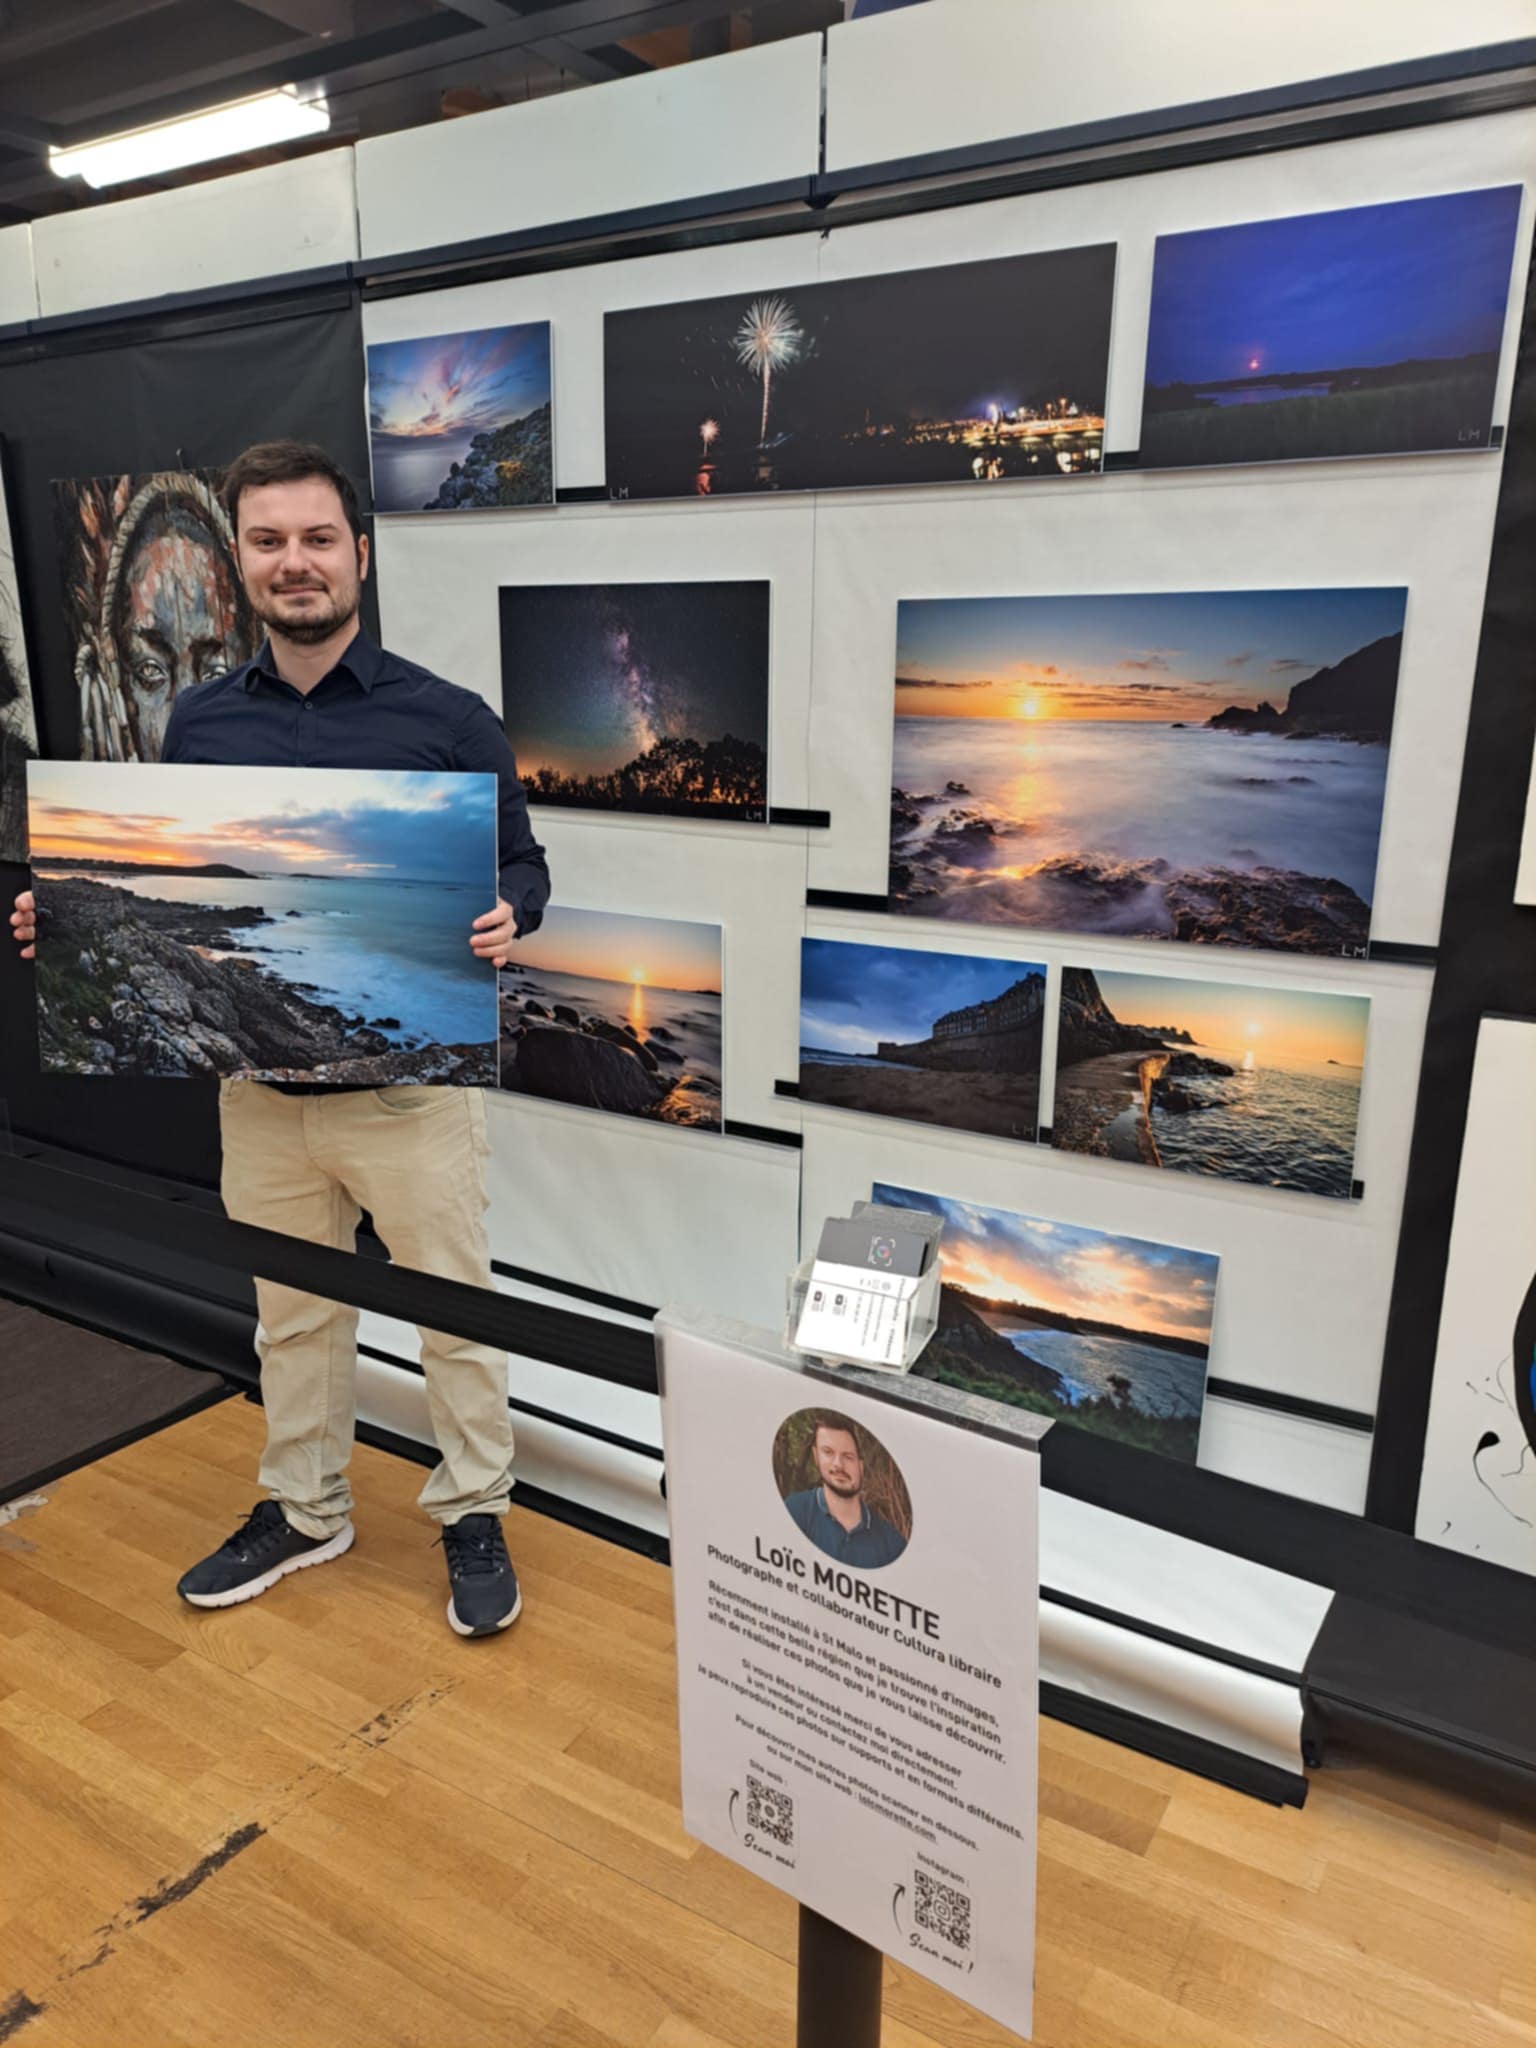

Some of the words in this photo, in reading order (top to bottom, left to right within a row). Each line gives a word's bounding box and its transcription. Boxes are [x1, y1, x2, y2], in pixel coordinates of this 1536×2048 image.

[609, 487, 629, 500] LM
[1341, 944, 1366, 957] LM
[707, 1544, 783, 1587] Photographe
[786, 1582, 799, 1594] et
[802, 1589, 889, 1636] collaborateur
[893, 1629, 945, 1664] Cultura
[949, 1653, 1002, 1689] libraire
[708, 1580, 769, 1616] Récemment
[771, 1609, 810, 1634] installé
[813, 1629, 819, 1639] à
[822, 1632, 833, 1646] St
[836, 1639, 863, 1660] Malo
[865, 1655, 876, 1667] et
[879, 1661, 938, 1696] passionné
[755, 1536, 806, 1577] Loïc
[813, 1561, 940, 1640] MORETTE
[708, 1611, 726, 1627] afin
[728, 1620, 740, 1633] de
[742, 1628, 781, 1652] réaliser
[784, 1648, 802, 1662] ces
[804, 1657, 841, 1681] photos
[843, 1675, 863, 1693] que
[866, 1686, 876, 1699] je
[879, 1695, 906, 1714] vous
[908, 1706, 942, 1732] laisse
[945, 1727, 1006, 1765] découvrir.
[733, 1608, 757, 1626] dans
[759, 1620, 786, 1639] cette
[789, 1632, 815, 1653] belle
[818, 1648, 851, 1669] région
[854, 1665, 874, 1681] que
[877, 1674, 888, 1689] je
[891, 1682, 927, 1707] trouve
[698, 1664, 707, 1675] Je
[708, 1670, 729, 1686] peux
[731, 1681, 776, 1710] reproduire
[778, 1706, 795, 1720] ces
[797, 1716, 828, 1738] photos
[831, 1733, 846, 1747] sur
[849, 1743, 892, 1772] supports
[894, 1767, 905, 1778] et
[908, 1773, 920, 1786] en
[923, 1779, 964, 1809] formats
[966, 1803, 1024, 1841] différents.
[742, 1658, 750, 1669] Si
[752, 1665, 773, 1681] vous
[844, 1711, 872, 1732] merci
[875, 1727, 887, 1739] de
[889, 1734, 913, 1752] vous
[916, 1749, 962, 1776] adresser
[754, 1680, 765, 1690] un
[767, 1686, 804, 1710] vendeur
[806, 1706, 818, 1718] ou
[820, 1714, 867, 1744] contactez
[870, 1740, 889, 1755] moi
[891, 1750, 958, 1791] directement.
[736, 1714, 754, 1730] Pour
[756, 1726, 795, 1751] découvrir
[797, 1748, 816, 1763] mes
[819, 1760, 846, 1779] autres
[848, 1775, 879, 1797] photos
[881, 1793, 919, 1818] scanner
[921, 1814, 934, 1826] en
[936, 1822, 979, 1851] dessous.
[779, 1752, 793, 1763] sur
[794, 1759, 814, 1775] mon
[816, 1771, 831, 1784] site
[834, 1781, 852, 1796] web
[744, 1833, 772, 1857] Scan
[917, 1852, 965, 1883] Instagram
[909, 1933, 939, 1957] Scan
